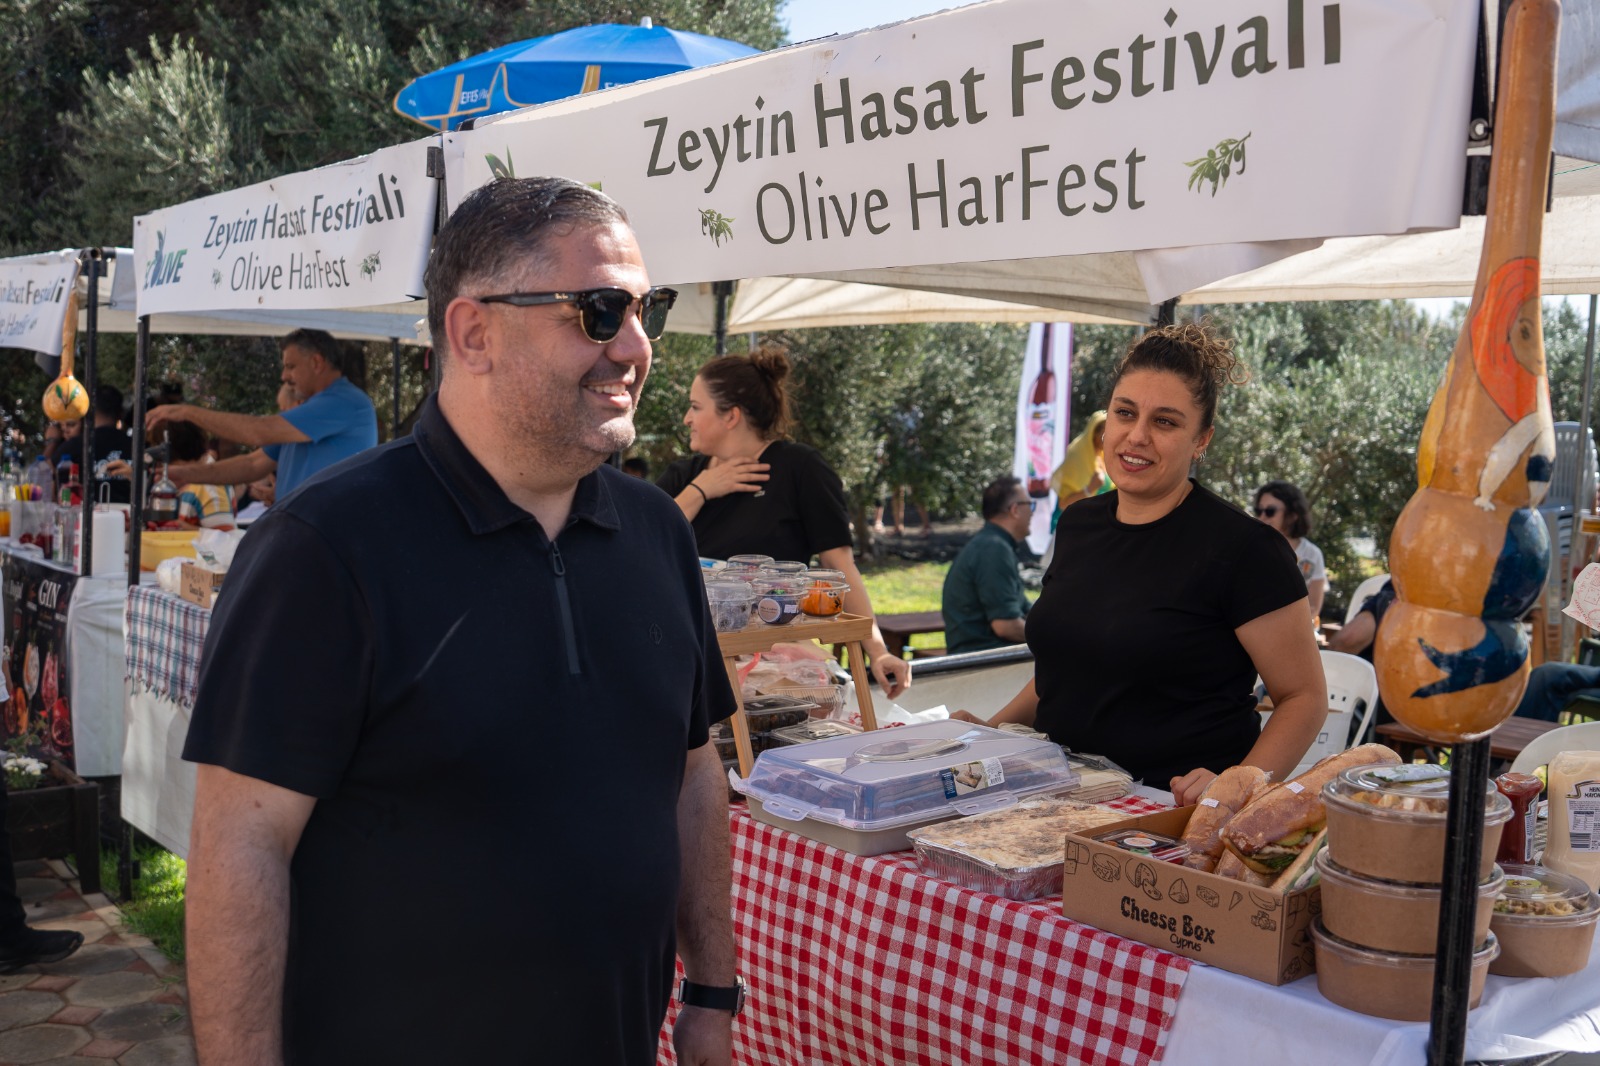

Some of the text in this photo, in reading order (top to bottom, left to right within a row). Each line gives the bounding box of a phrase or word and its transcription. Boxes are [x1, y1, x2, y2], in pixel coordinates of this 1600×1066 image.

[644, 0, 1341, 194] Zeytin Hasat Festivali
[203, 172, 405, 260] Zeytin Hasat Festivali
[757, 145, 1147, 245] Olive HarFest
[231, 250, 350, 291] Olive HarFest
[38, 579, 61, 609] GIN
[1120, 896, 1216, 944] Cheese Box
[1169, 933, 1202, 952] Cyprus
